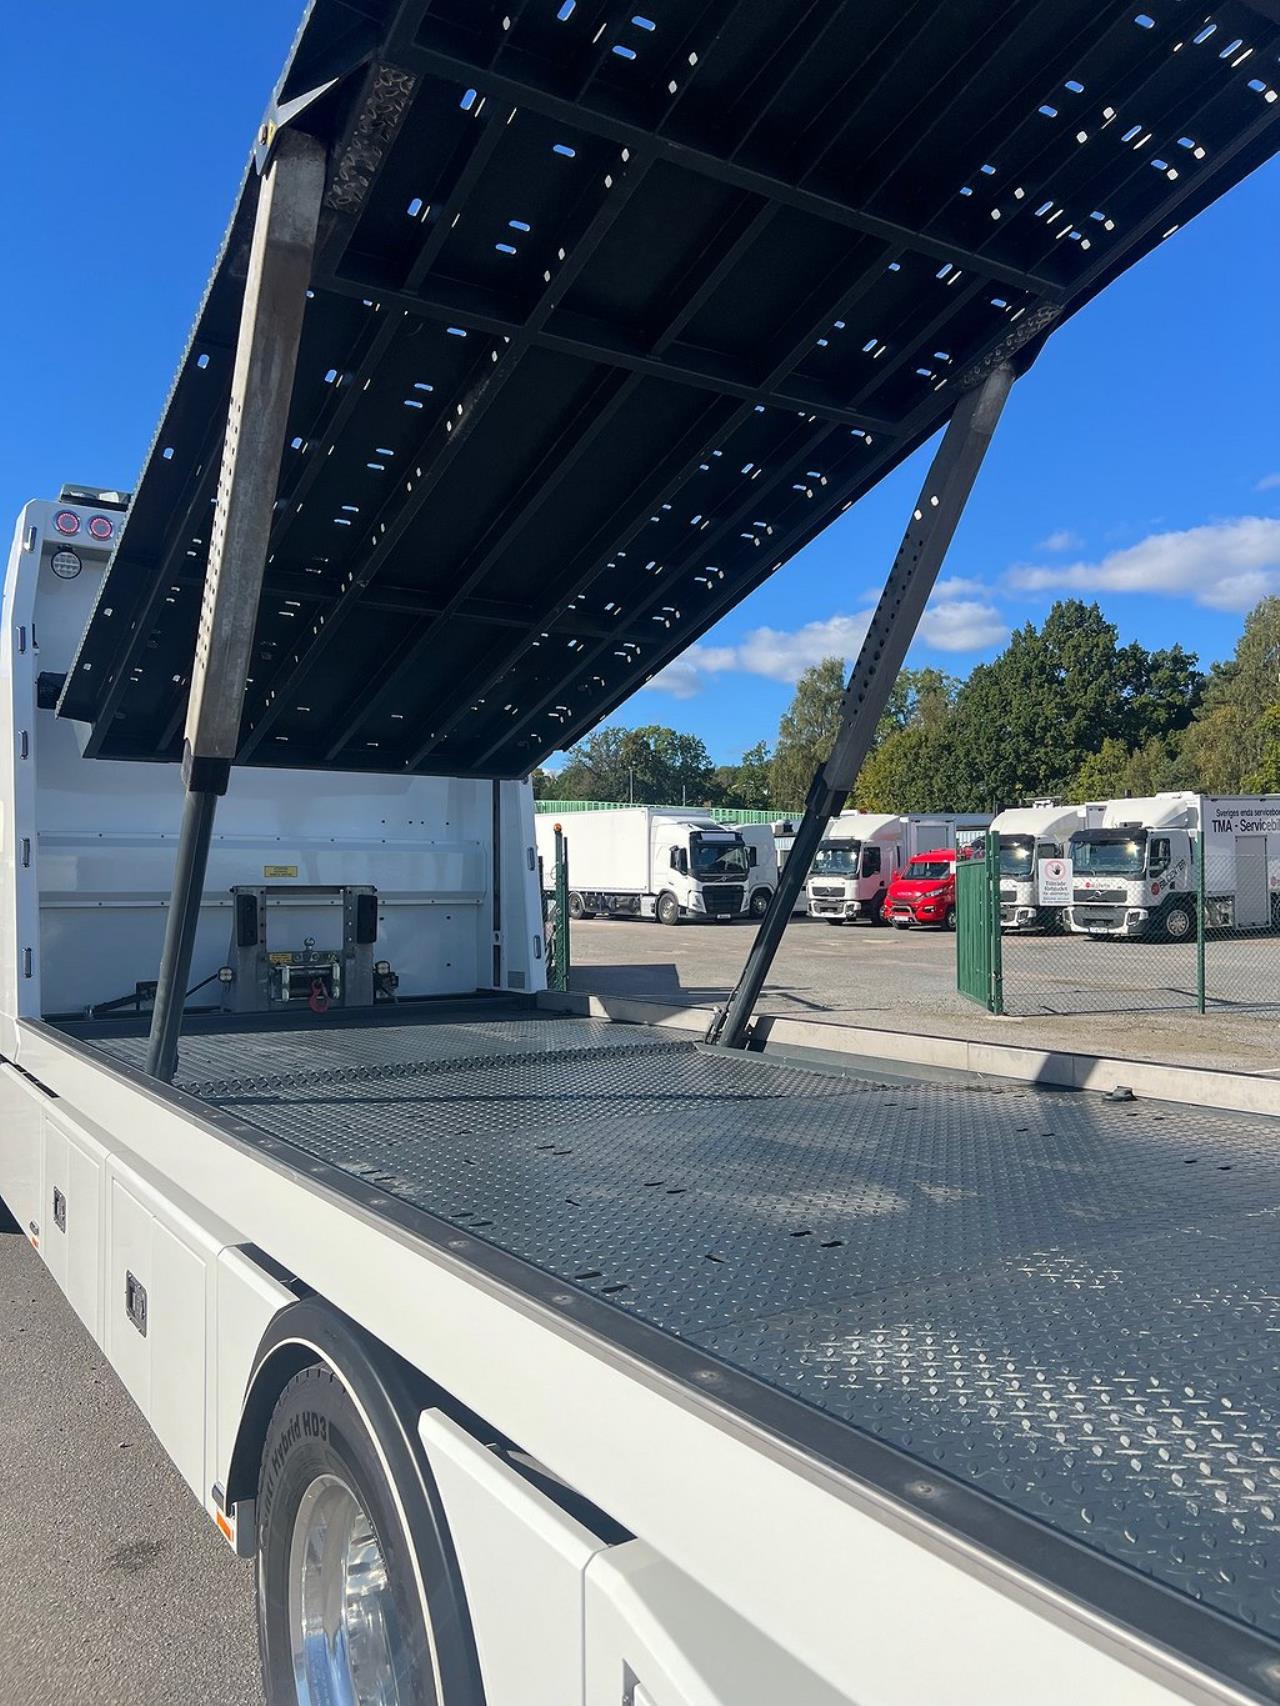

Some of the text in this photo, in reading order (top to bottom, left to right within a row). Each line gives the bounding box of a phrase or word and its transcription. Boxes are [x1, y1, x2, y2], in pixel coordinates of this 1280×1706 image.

[1216, 808, 1239, 819] Sveriges
[1240, 808, 1253, 817] enda
[1212, 819, 1233, 832] TMA
[272, 1414, 302, 1476] Hybrid
[302, 1411, 327, 1441] HD3
